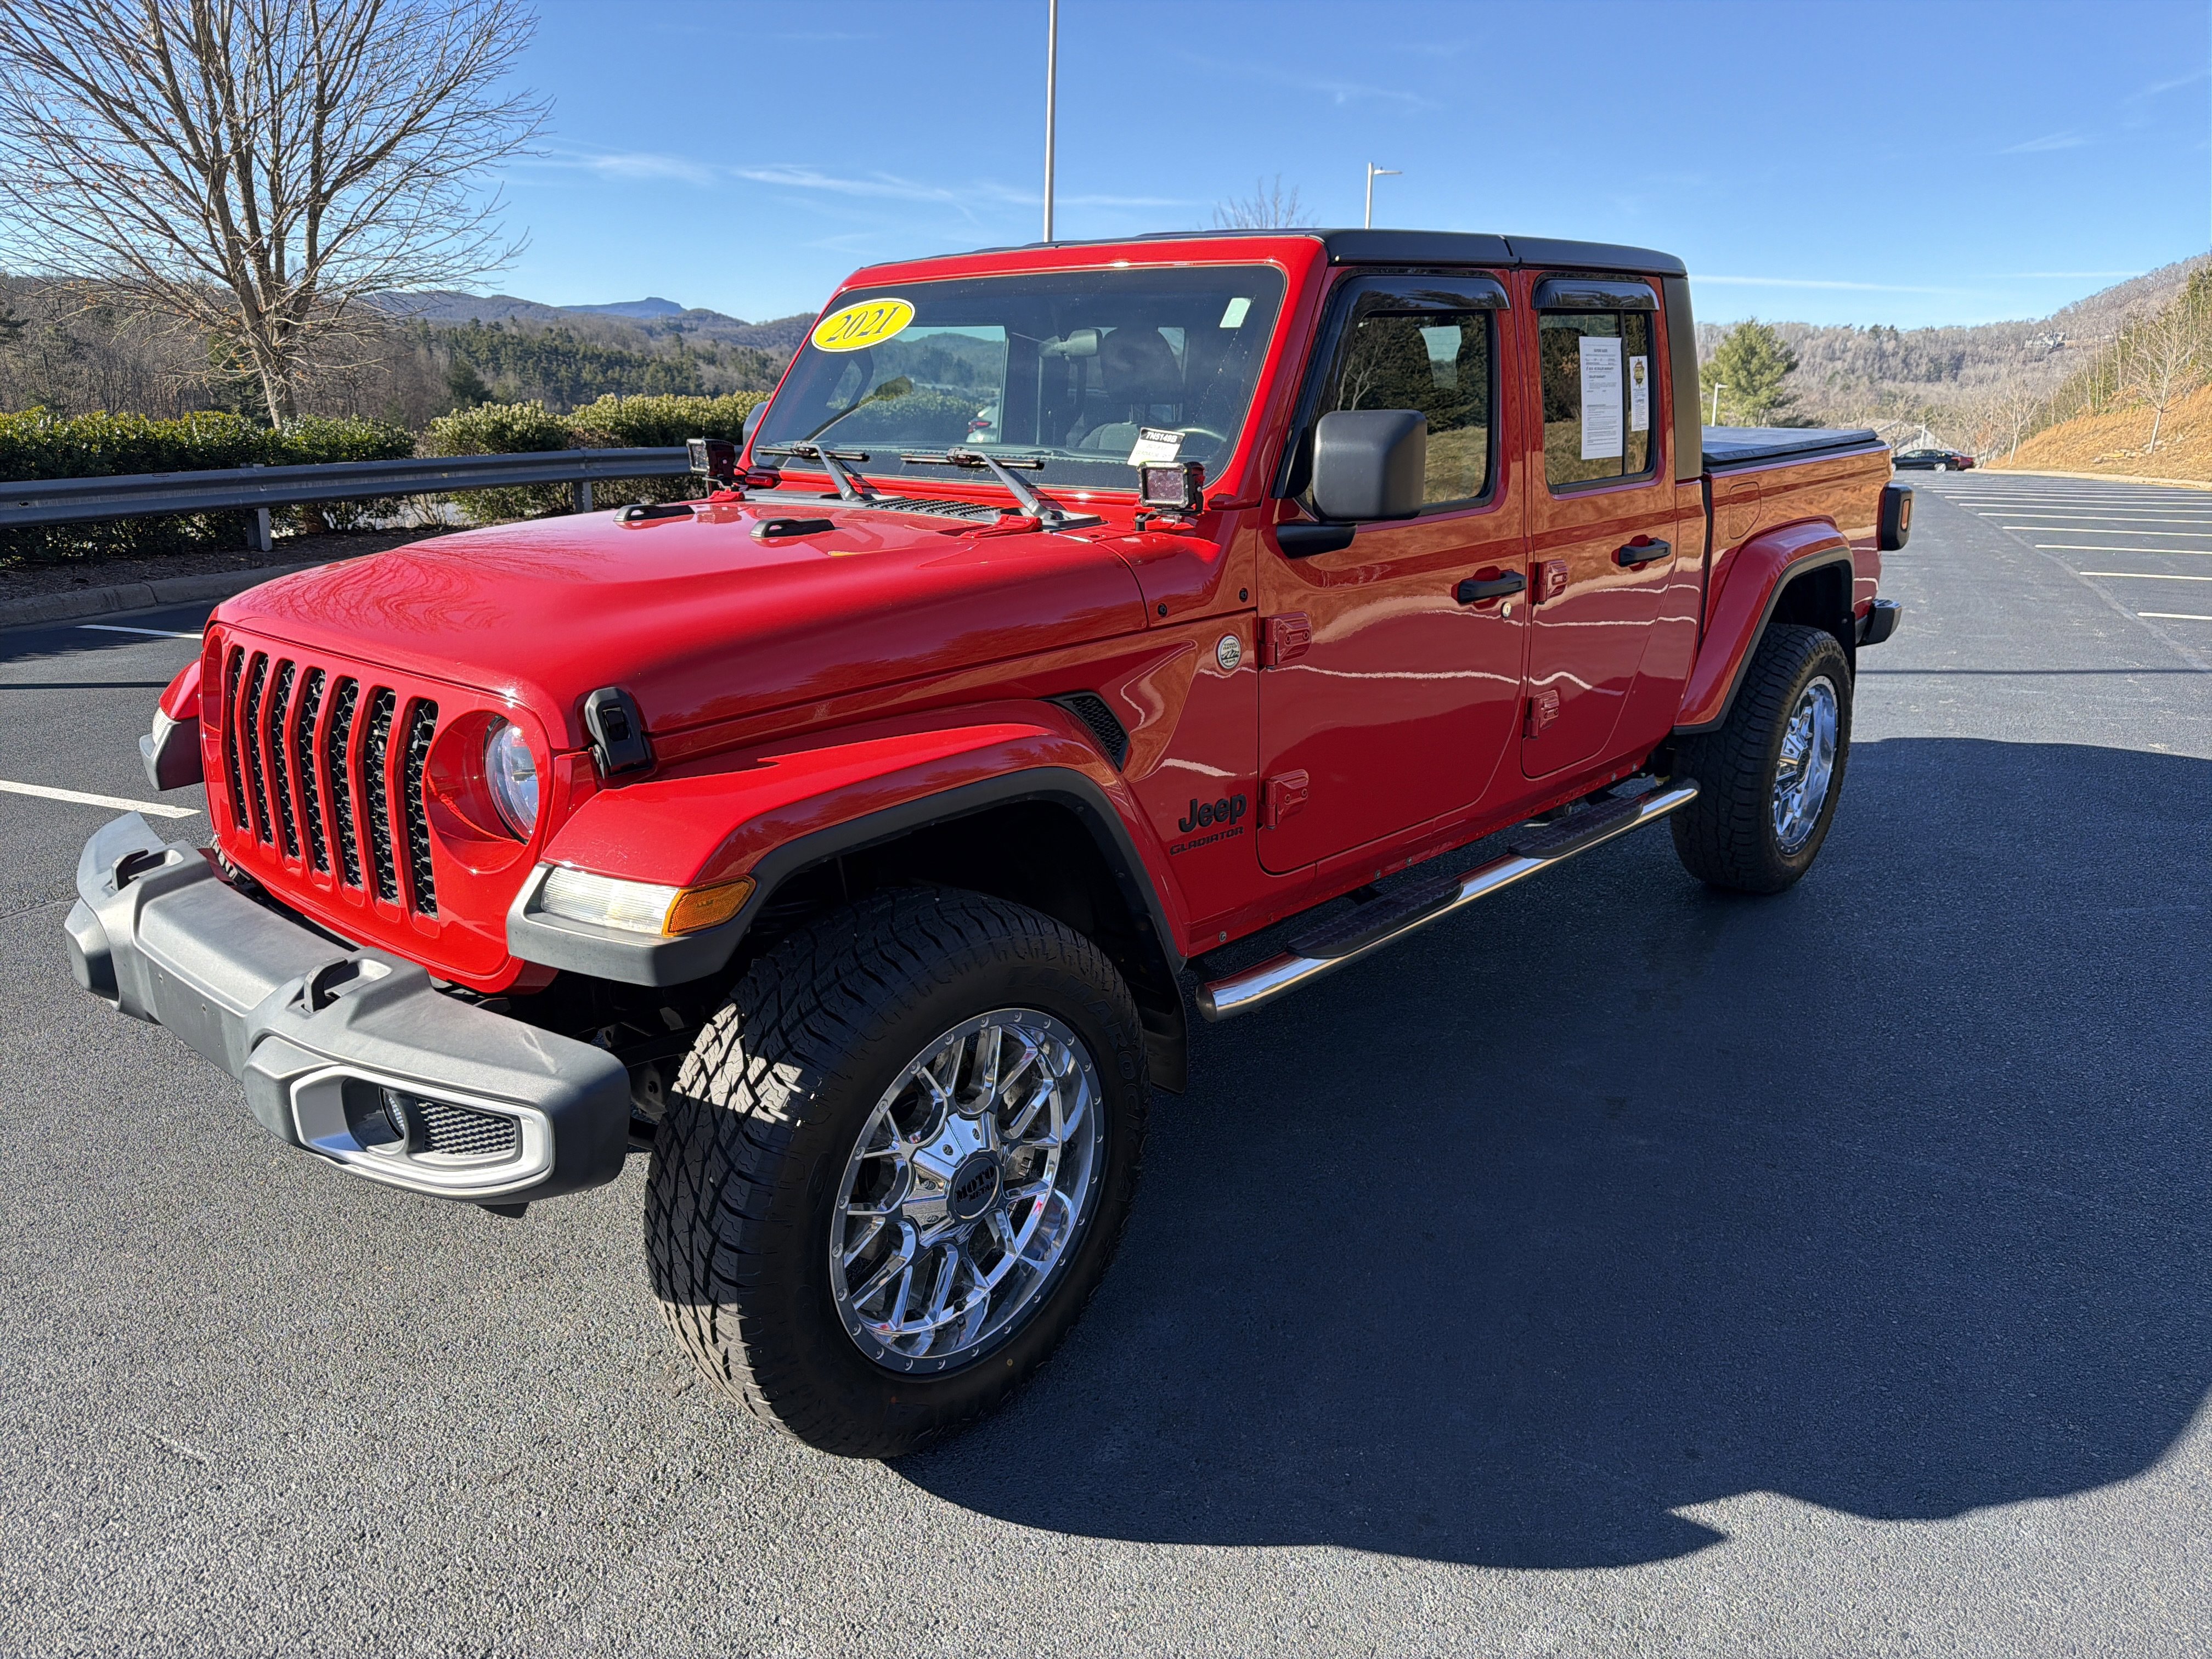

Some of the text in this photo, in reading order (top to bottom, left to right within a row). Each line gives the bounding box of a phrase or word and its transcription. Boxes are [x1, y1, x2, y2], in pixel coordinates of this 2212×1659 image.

[826, 306, 900, 342] 2021
[1178, 793, 1246, 832] Jeep
[1170, 826, 1244, 855] GLADIATOR
[955, 1164, 995, 1203] MOTO
